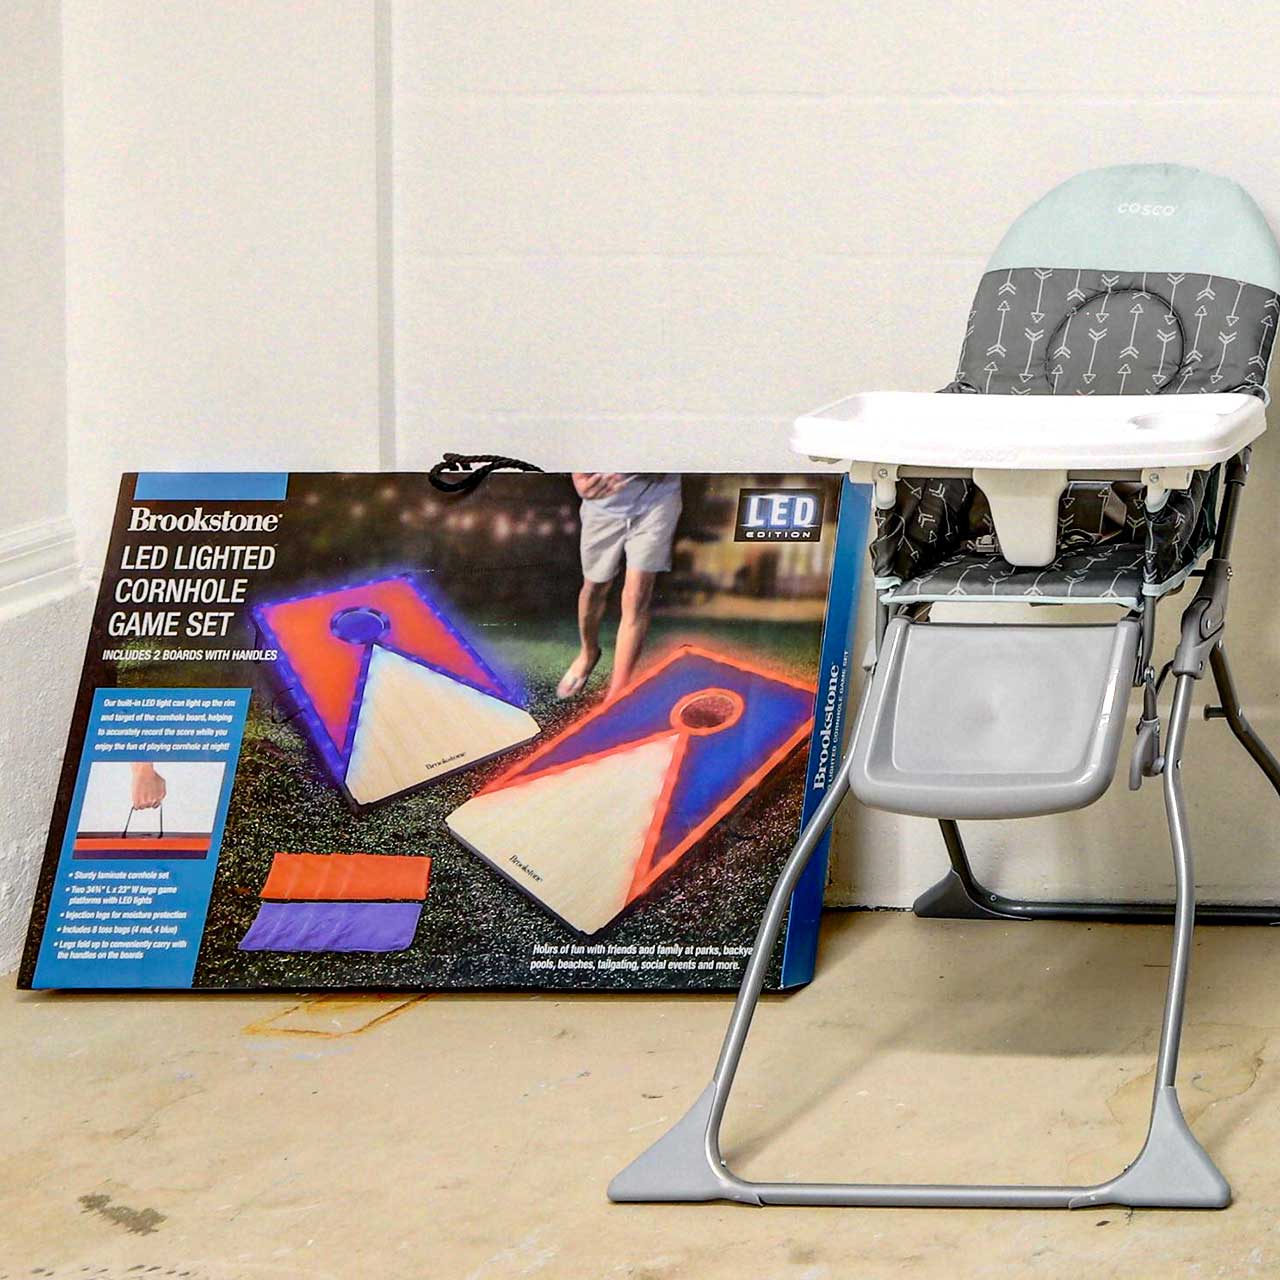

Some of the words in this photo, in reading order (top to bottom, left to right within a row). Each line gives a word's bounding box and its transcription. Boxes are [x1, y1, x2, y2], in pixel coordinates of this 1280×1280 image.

[1118, 202, 1176, 216] COSCO
[747, 494, 815, 526] LED
[127, 507, 279, 532] Brookstone
[120, 545, 168, 570] LED
[174, 545, 276, 570] LIGHTED
[115, 578, 248, 603] CORNHOLE
[108, 612, 181, 637] GAME
[185, 612, 234, 637] SET
[102, 650, 151, 661] INCLUDES
[153, 650, 161, 661] 2
[162, 650, 203, 661] BOARDS
[205, 650, 230, 661] WITH
[231, 650, 277, 661] HANDLES
[104, 699, 116, 707] Our
[117, 699, 141, 707] built-in
[142, 699, 155, 707] LED
[156, 699, 171, 708] light
[186, 699, 200, 708] light
[202, 700, 211, 708] up
[212, 699, 223, 707] the
[223, 699, 235, 707] rim
[115, 714, 135, 723] target
[186, 714, 207, 722] board,
[208, 714, 233, 723] helping
[98, 728, 105, 736] to
[106, 728, 140, 737] accurately
[141, 728, 163, 736] record
[164, 728, 175, 736] the
[196, 728, 214, 736] while
[215, 729, 228, 737] you
[813, 665, 839, 789] Brookstone
[95, 743, 113, 752] enjoy
[114, 743, 125, 751] the
[126, 743, 137, 751] fun
[138, 743, 146, 751] of
[147, 743, 171, 752] playing
[172, 743, 200, 751] cornhole
[202, 743, 209, 751] at
[533, 944, 558, 954] Hours
[560, 944, 571, 954] of
[571, 944, 585, 954] fun
[587, 944, 606, 954] with
[607, 944, 637, 954] friends
[639, 944, 655, 954] and
[657, 944, 682, 956] family
[684, 944, 694, 954] at
[695, 944, 721, 956] parks,
[723, 945, 753, 957] backya
[530, 960, 556, 970] pools,
[558, 960, 595, 970] beaches,
[597, 960, 640, 970] tailgating,
[640, 960, 667, 970] social
[668, 960, 696, 970] events
[698, 960, 714, 970] and
[715, 960, 740, 970] more.
